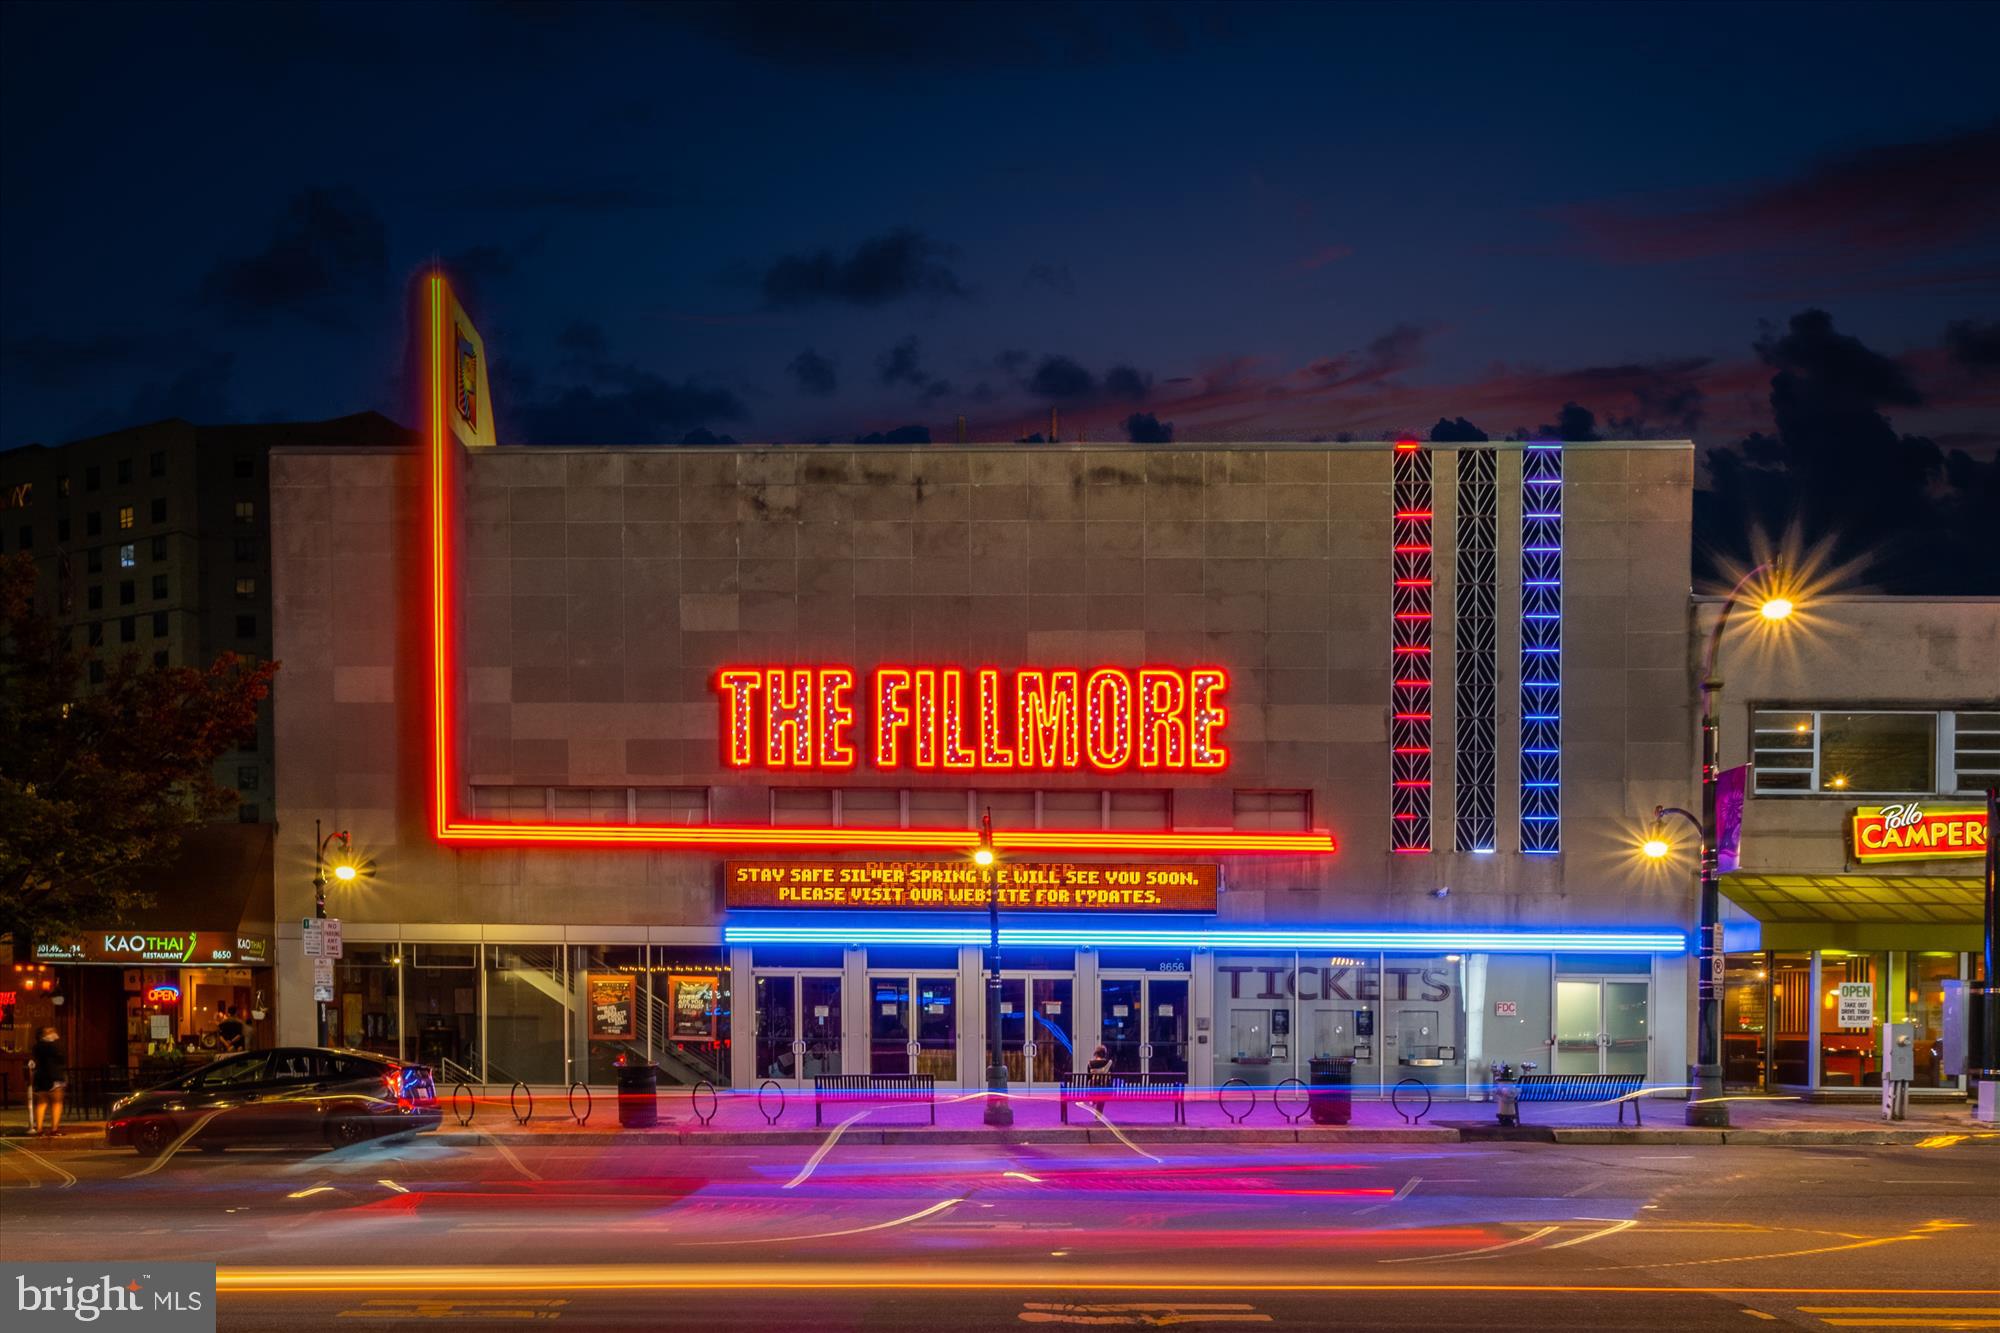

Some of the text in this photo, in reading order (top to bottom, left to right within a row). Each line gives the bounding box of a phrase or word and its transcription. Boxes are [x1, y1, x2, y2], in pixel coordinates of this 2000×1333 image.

[720, 669, 1226, 769] THE FILLMORE
[1880, 802, 1923, 830] Pollo
[737, 868, 785, 882] STAY
[790, 869, 834, 882] SAFE
[910, 870, 976, 883] SPRING
[1014, 871, 1060, 884] WILL
[1065, 871, 1100, 884] SEE
[1105, 872, 1141, 885] YOU
[1146, 872, 1199, 885] SOON.
[779, 887, 845, 901] PLEASE
[851, 888, 904, 901] VISIT
[910, 888, 945, 901] OUR
[1036, 889, 1070, 902] FOR
[143, 952, 184, 960] RESTAURANT
[213, 950, 232, 960] 8650
[1159, 962, 1185, 972] 8656
[1218, 965, 1451, 1001] TICKETS
[148, 989, 176, 1001] OPEN
[1841, 985, 1871, 998] OPEN
[1496, 1002, 1516, 1013] FDC
